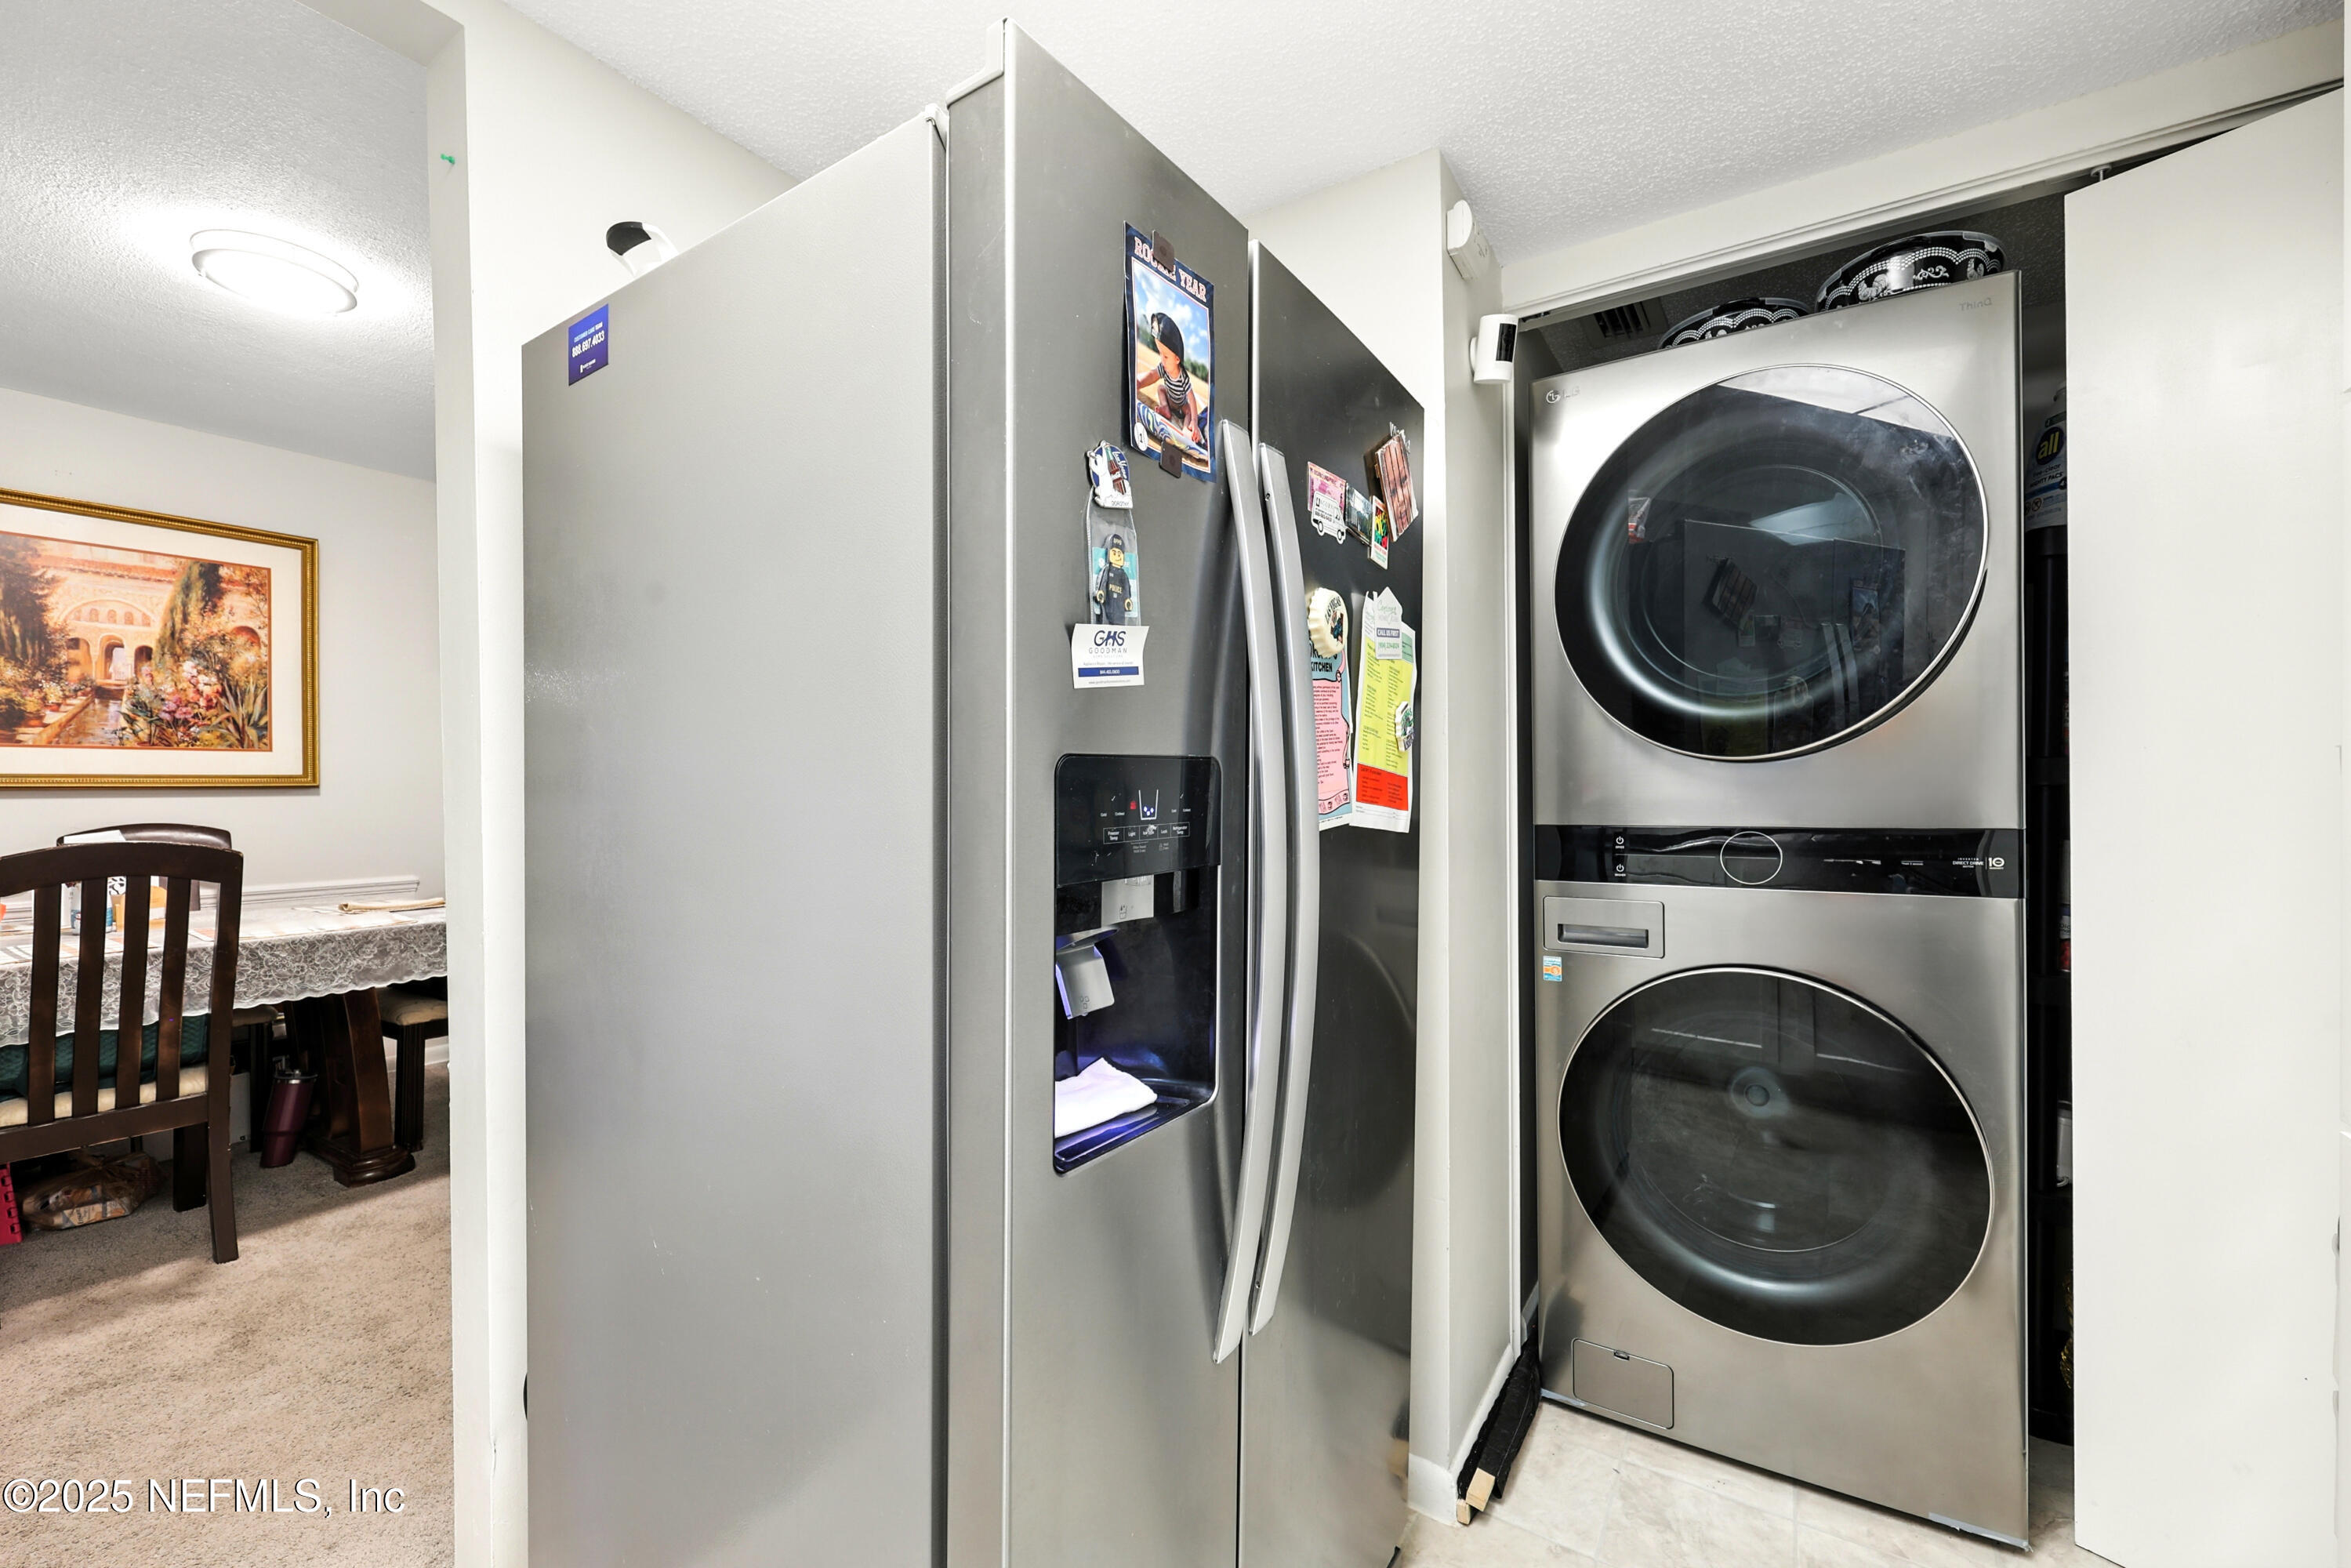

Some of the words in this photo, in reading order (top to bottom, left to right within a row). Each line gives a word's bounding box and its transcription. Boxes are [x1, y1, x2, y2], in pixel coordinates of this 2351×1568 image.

[1178, 268, 1206, 303] YEAR
[1959, 297, 1993, 311] ThinQ
[2038, 431, 2060, 460] all
[2048, 472, 2063, 482] PACS
[1108, 584, 1123, 594] POLICE
[1330, 596, 1341, 612] VEGAS
[1094, 630, 1127, 647] GHS
[1988, 857, 2005, 867] 10
